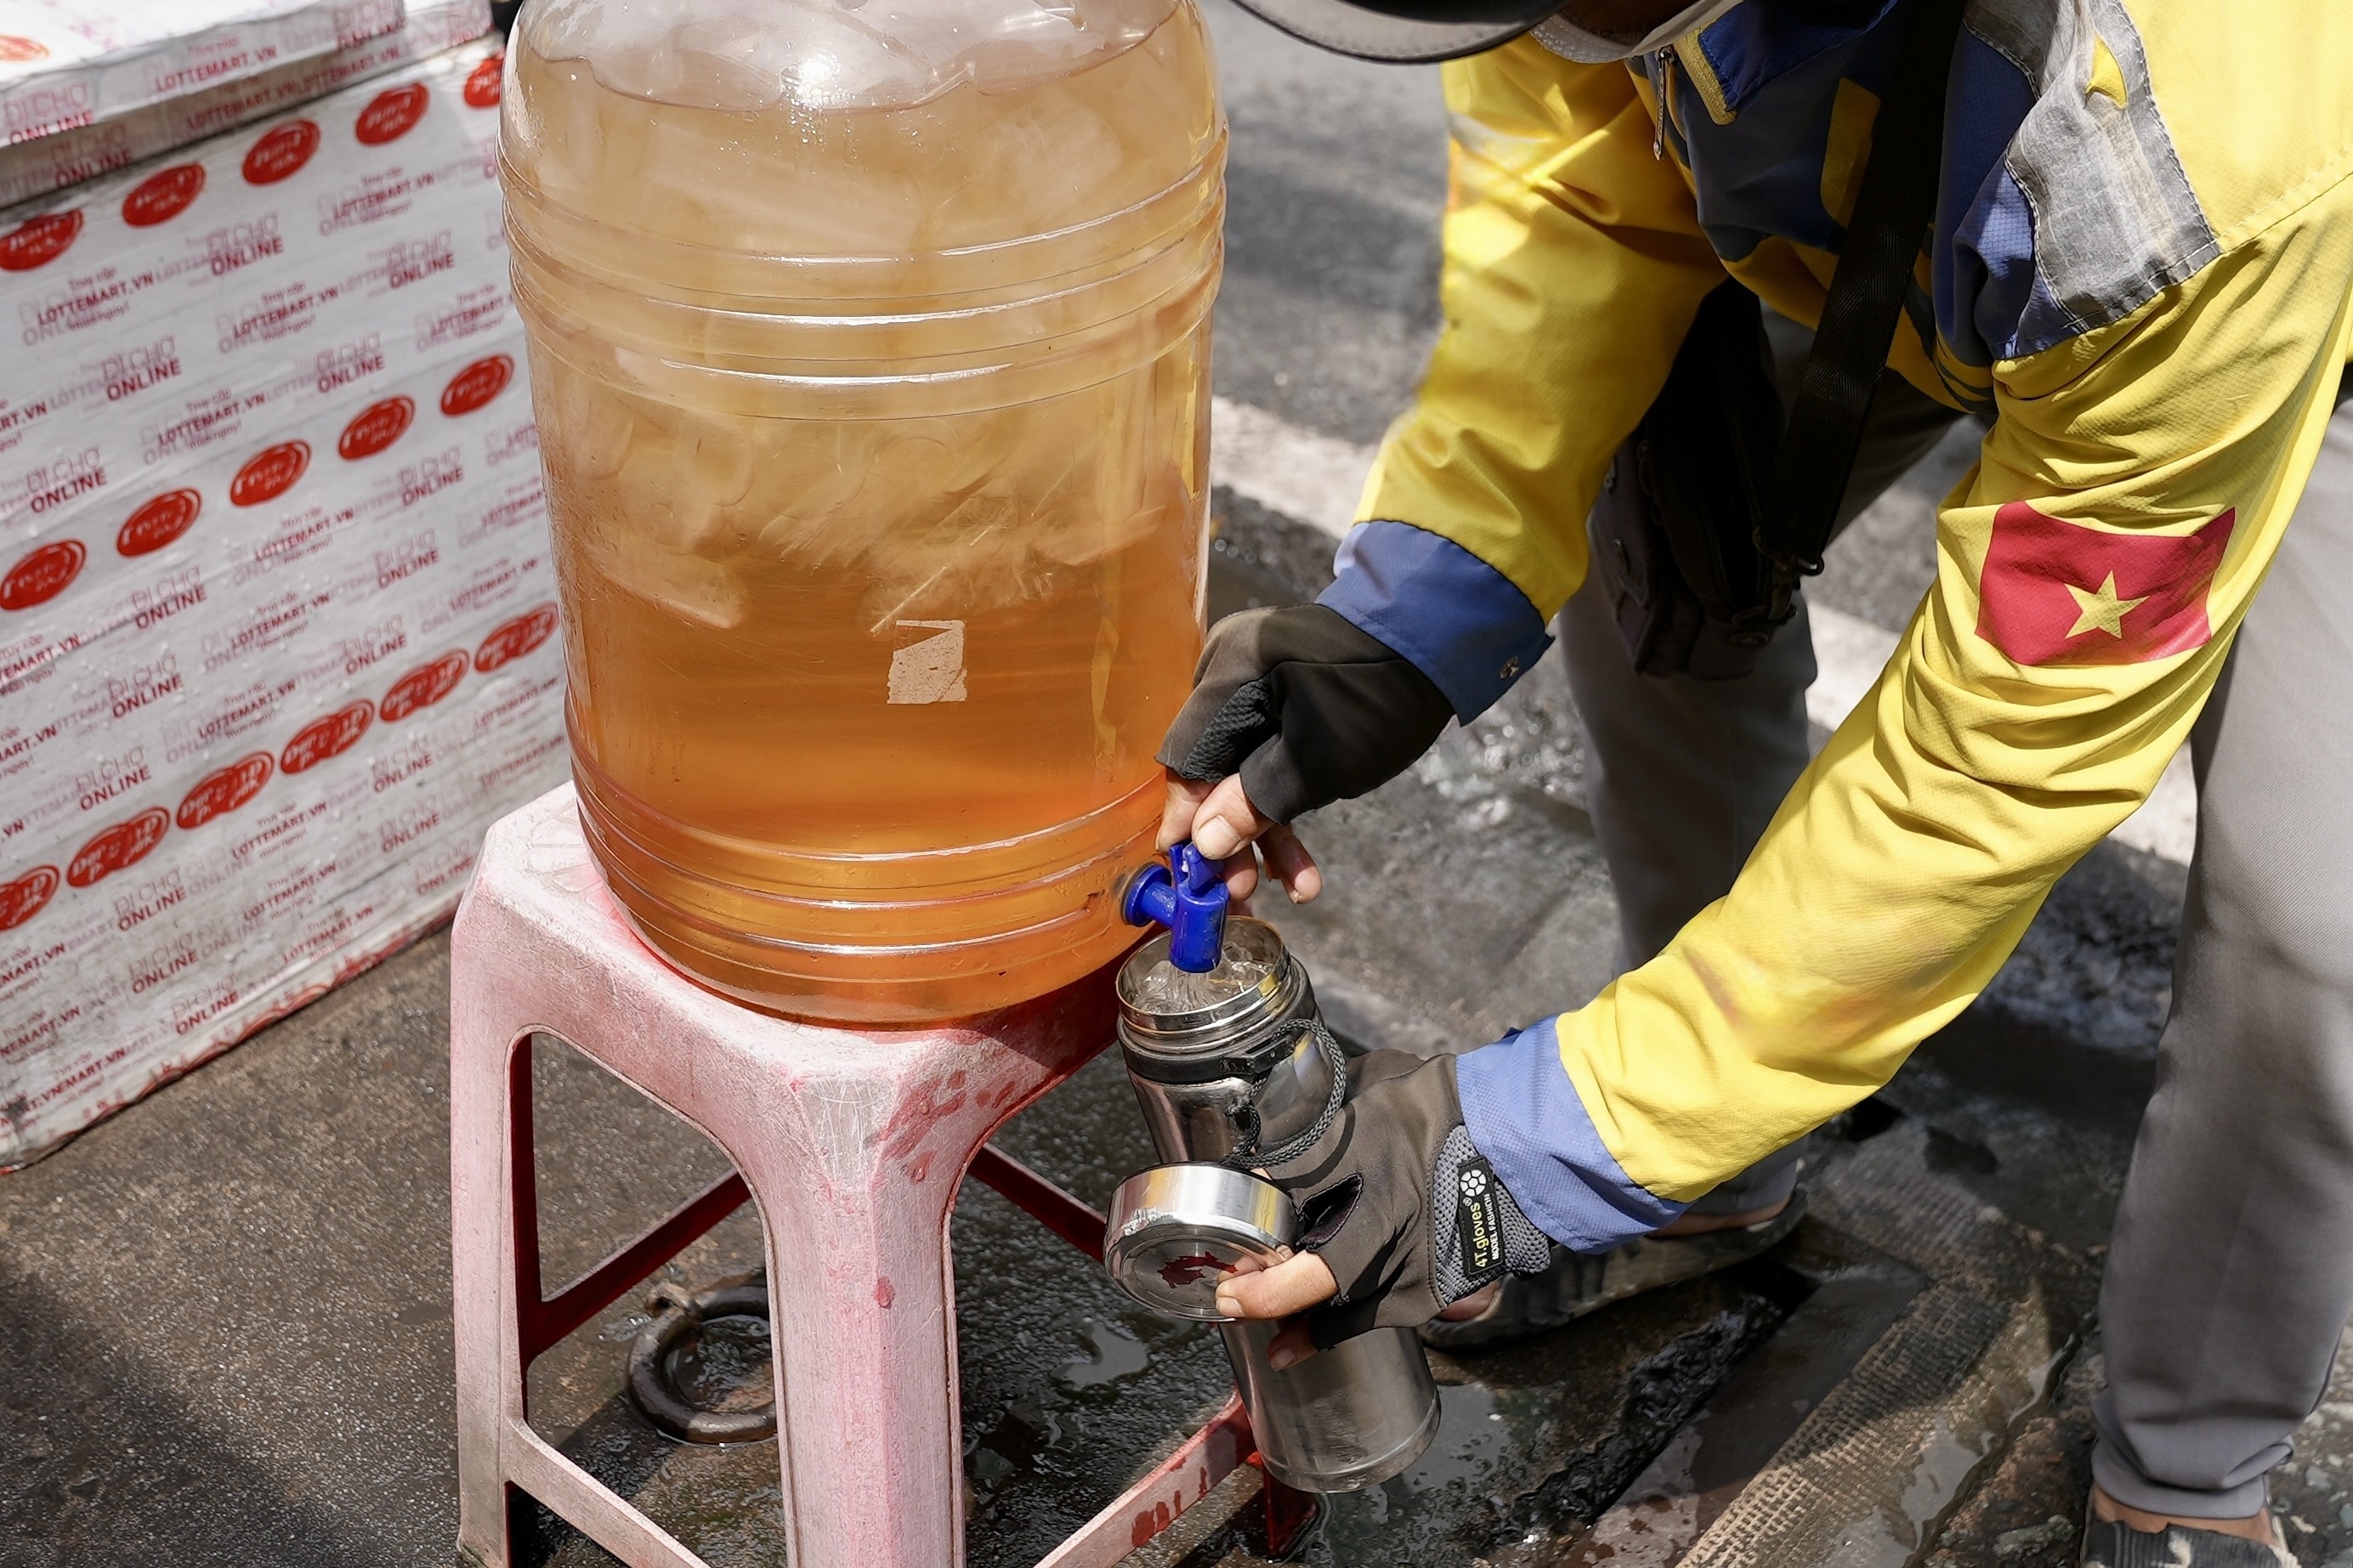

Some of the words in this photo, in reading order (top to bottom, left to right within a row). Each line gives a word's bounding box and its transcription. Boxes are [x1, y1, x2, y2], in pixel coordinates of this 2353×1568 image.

[155, 44, 276, 93] LOTTEMART.VN
[211, 235, 284, 276] ONLINE
[389, 249, 456, 289] ONLINE
[37, 271, 155, 324] LOTTEMART.VN
[233, 286, 338, 339] LOTTEMART.VN
[105, 357, 183, 403] ONLINE
[317, 352, 386, 394] ONLINE
[157, 391, 266, 447] LOTTEMART.VN
[31, 466, 108, 514] ONLINE
[401, 463, 465, 507] ONLINE
[256, 507, 354, 562] LOTTEMART.VN
[377, 546, 440, 589] ONLINE
[136, 582, 209, 630] ONLINE
[231, 591, 330, 649] LOTTEMART.VN
[345, 631, 407, 676] ONLINE
[113, 671, 184, 719] ONLINE
[198, 679, 298, 739] LOTTEMART.VN
[79, 763, 152, 812] ONLINE
[373, 752, 433, 795] ONLINE
[232, 801, 327, 860] LOTTEMART.VN
[381, 810, 440, 853] ONLINE
[117, 884, 187, 932] ONLINE
[243, 861, 337, 921] LOTTEMART.VN
[281, 904, 374, 964] LOTTEMART.VN
[132, 947, 201, 994] ONLINE
[1488, 1231, 1500, 1260] MODEL
